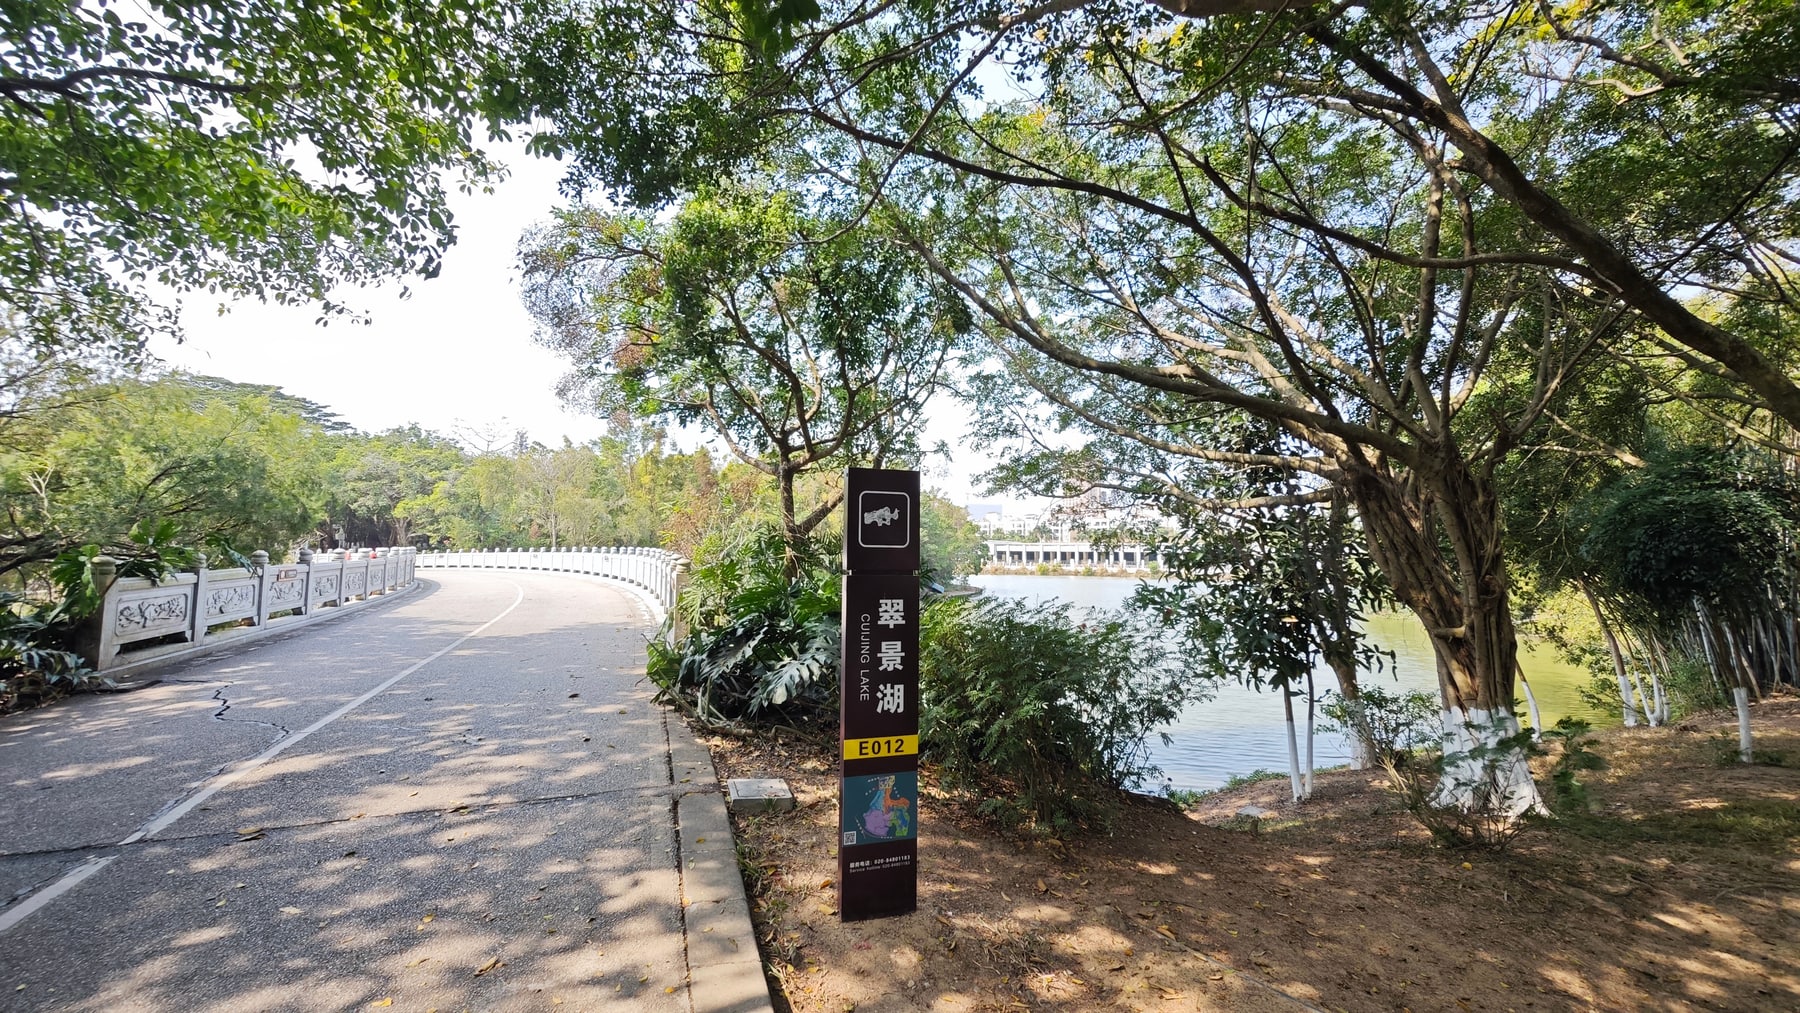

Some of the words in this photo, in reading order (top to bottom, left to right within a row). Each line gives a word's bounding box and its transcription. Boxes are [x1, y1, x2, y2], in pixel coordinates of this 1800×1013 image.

[860, 613, 870, 664] CUIJING
[876, 599, 906, 714] 翠景湖
[860, 669, 870, 702] LAKE
[859, 738, 905, 756] E012
